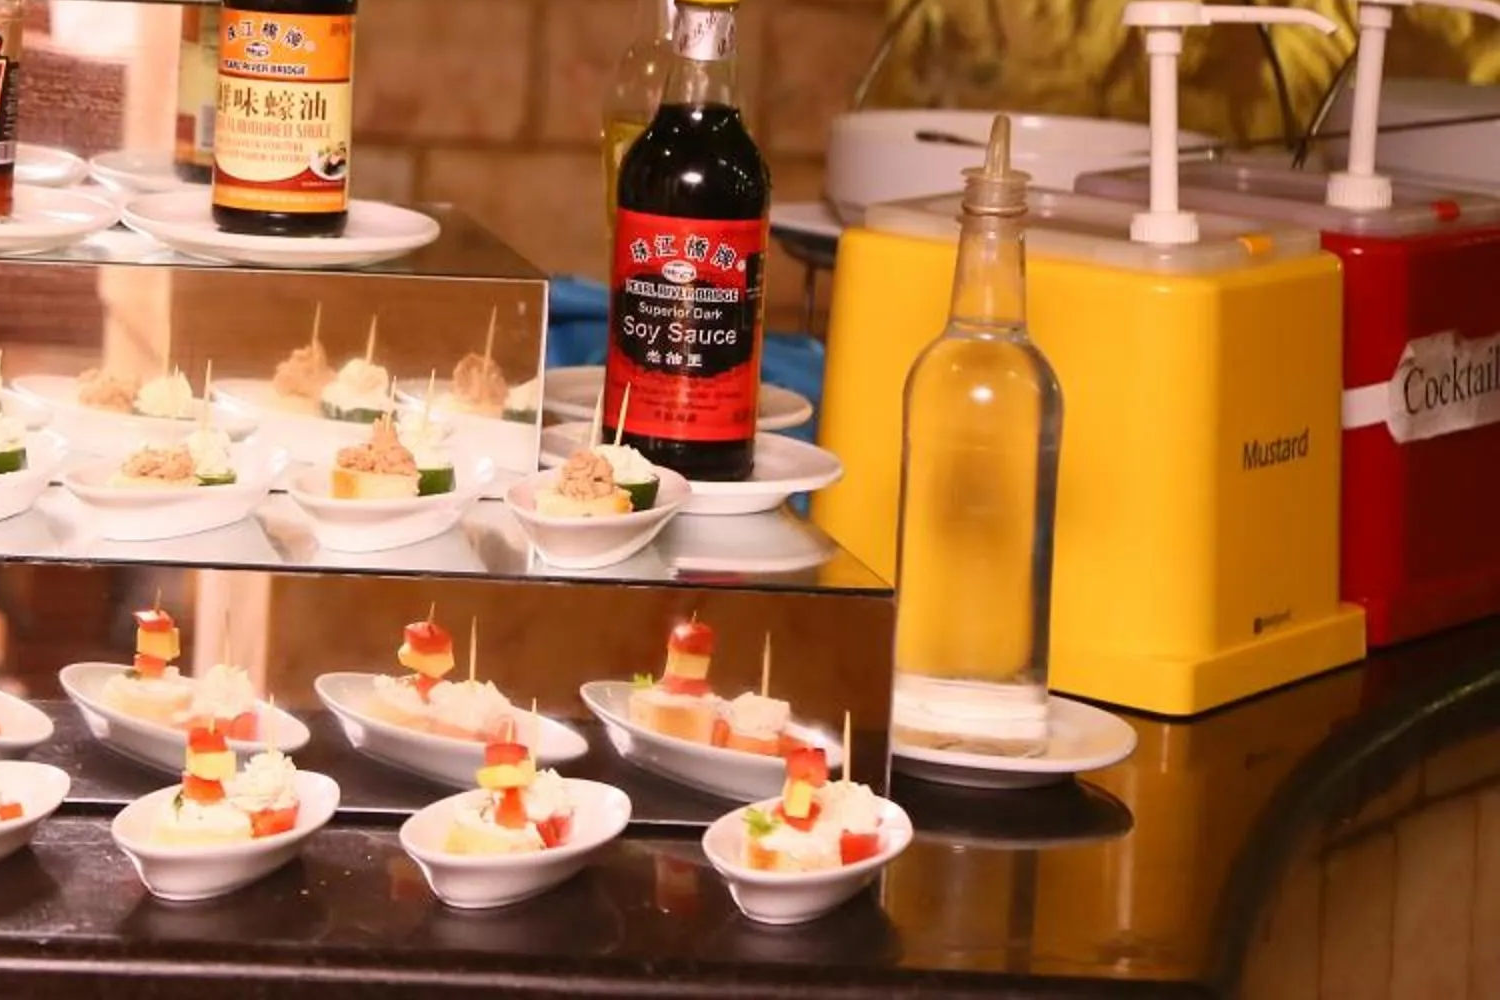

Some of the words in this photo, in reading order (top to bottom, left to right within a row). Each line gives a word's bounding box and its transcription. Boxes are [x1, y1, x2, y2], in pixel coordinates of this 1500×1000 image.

[695, 287, 739, 302] BRIDGE
[638, 301, 690, 318] Superior
[693, 307, 723, 319] Dark
[623, 315, 661, 345] Soy
[667, 322, 737, 345] Sauce
[1403, 343, 1500, 417] Cocktail
[1242, 428, 1311, 472] Mustard
